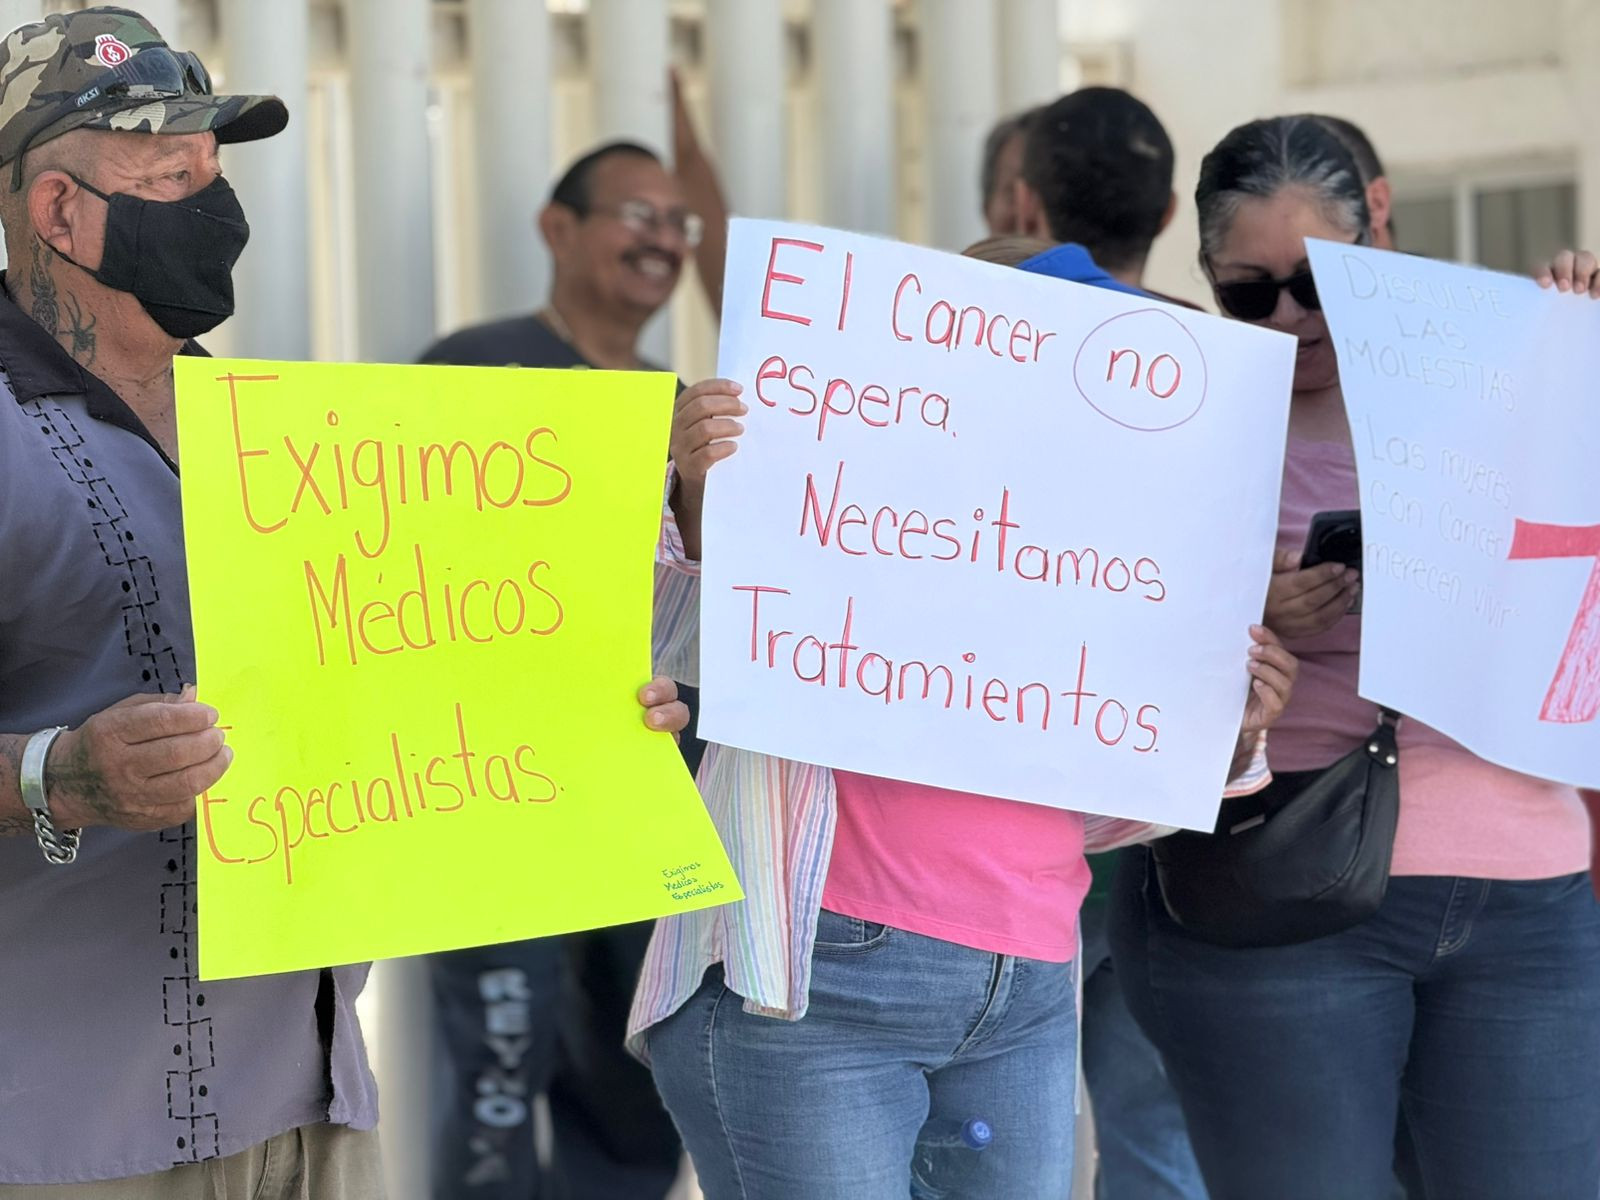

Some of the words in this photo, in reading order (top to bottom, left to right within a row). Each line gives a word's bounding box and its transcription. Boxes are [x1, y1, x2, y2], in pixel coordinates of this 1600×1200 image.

[762, 238, 853, 332] El
[892, 273, 1057, 363] Cancer
[1106, 348, 1182, 399] no
[1341, 254, 1511, 318] DISCULPE
[1393, 313, 1467, 351] LAS
[756, 356, 957, 441] espera.
[1345, 337, 1518, 413] MOLESTIAS
[216, 373, 572, 558] Exigimos
[1440, 445, 1512, 511] mujeres
[800, 461, 1166, 601] Necesitamos
[1438, 500, 1505, 561] Cancer
[303, 544, 564, 666] Médicos
[1366, 542, 1463, 606] merecen
[1507, 518, 1600, 723] 7
[732, 585, 1160, 752] Tratamientos.
[662, 862, 701, 880] Exigimos
[672, 881, 724, 900] Especialistas
